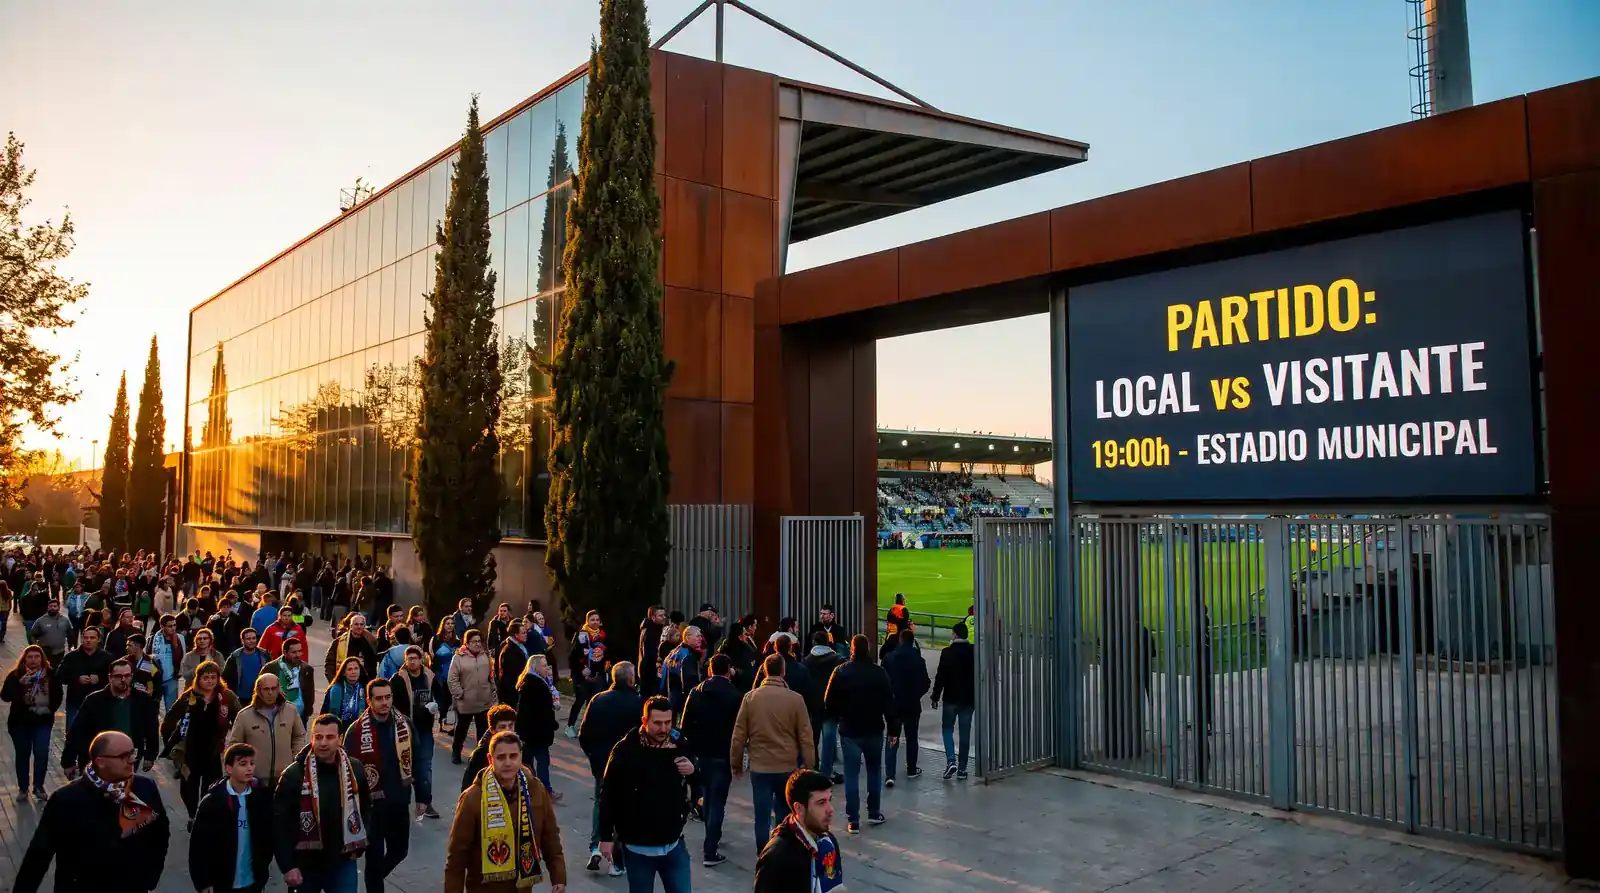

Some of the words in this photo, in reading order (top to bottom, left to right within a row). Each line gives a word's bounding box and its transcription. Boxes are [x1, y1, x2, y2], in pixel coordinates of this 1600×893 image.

[1167, 278, 1377, 352] PARTIDO:
[1095, 371, 1200, 419] LOCAL
[1262, 341, 1487, 406] VISITANTE
[1092, 436, 1170, 469] 19:00h
[1197, 428, 1308, 465] ESTADIO
[1317, 418, 1498, 460] MUNICIPAL
